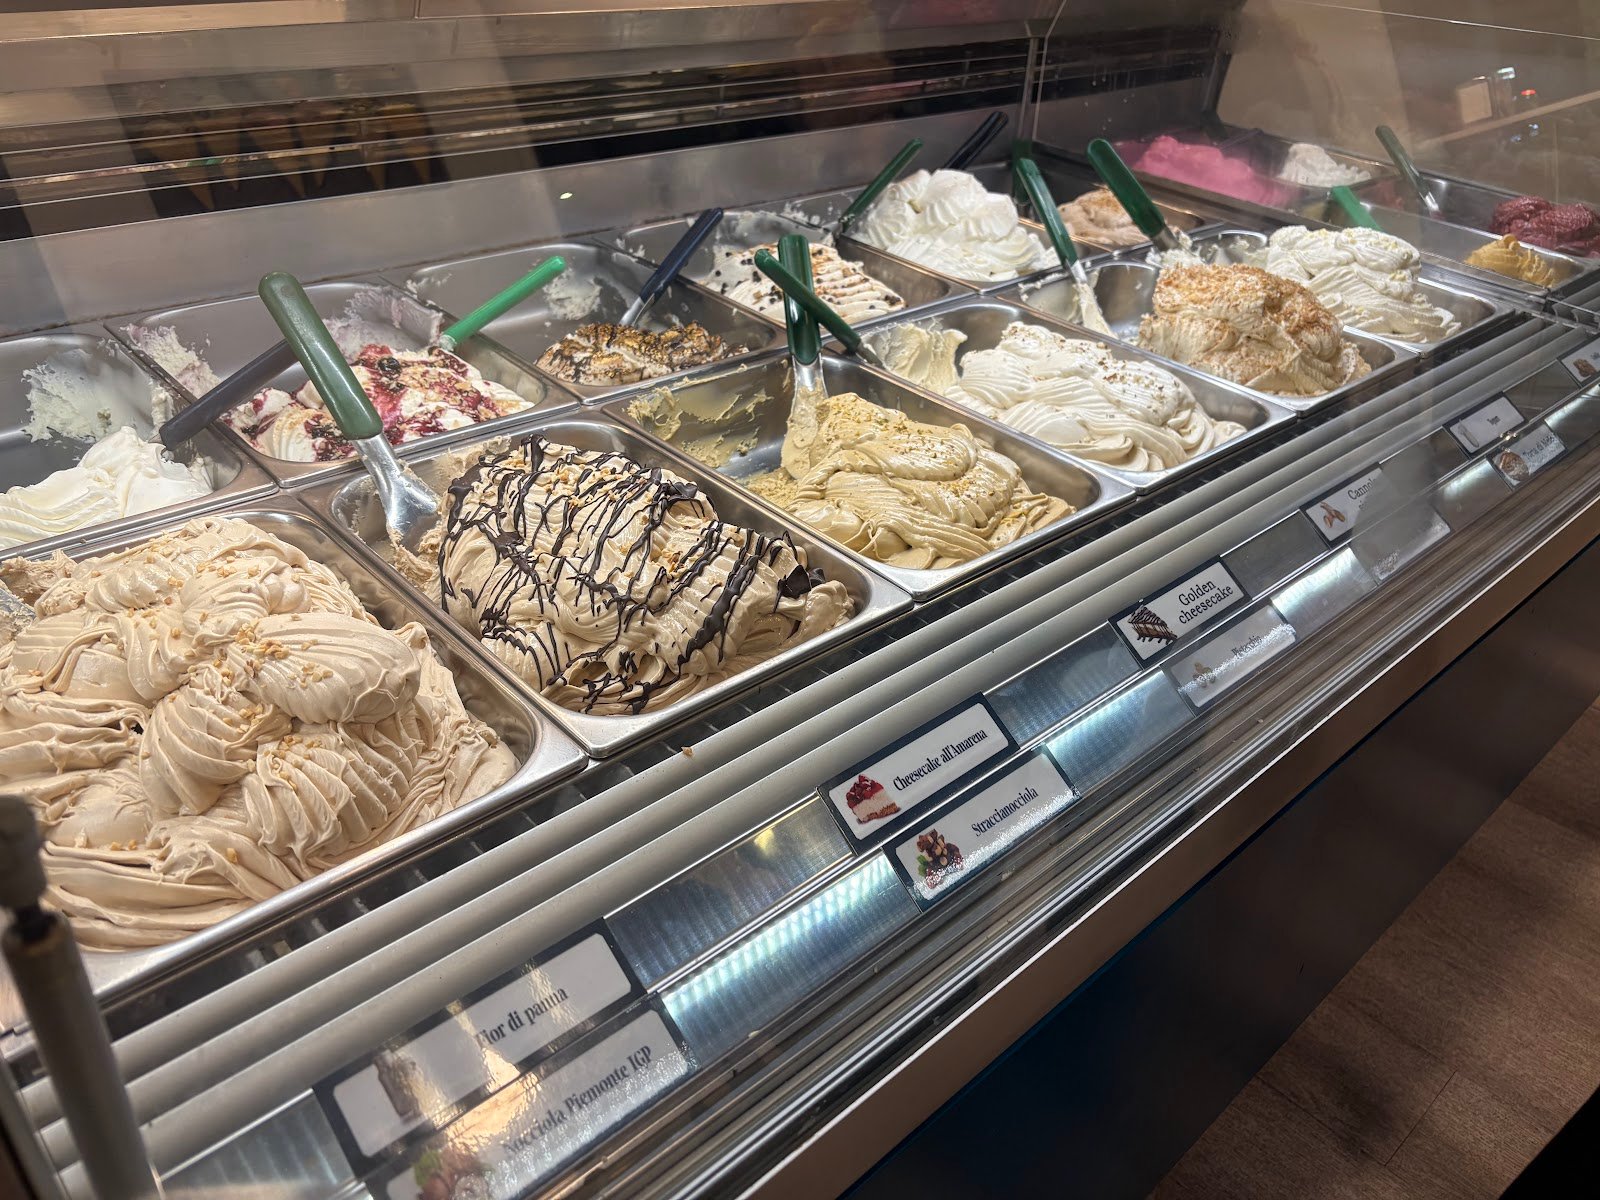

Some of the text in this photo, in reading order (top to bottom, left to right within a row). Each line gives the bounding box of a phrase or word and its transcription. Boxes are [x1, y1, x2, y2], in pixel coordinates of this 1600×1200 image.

[1178, 580, 1216, 606] Golden
[1178, 585, 1234, 625] cheesecake
[892, 729, 988, 791] Cheesecake all'Amarena
[971, 786, 1039, 837] Straccianocciola
[507, 1010, 525, 1032] di
[523, 988, 569, 1025] panna
[563, 1064, 630, 1115] Piemonte
[626, 1045, 652, 1071] IGP
